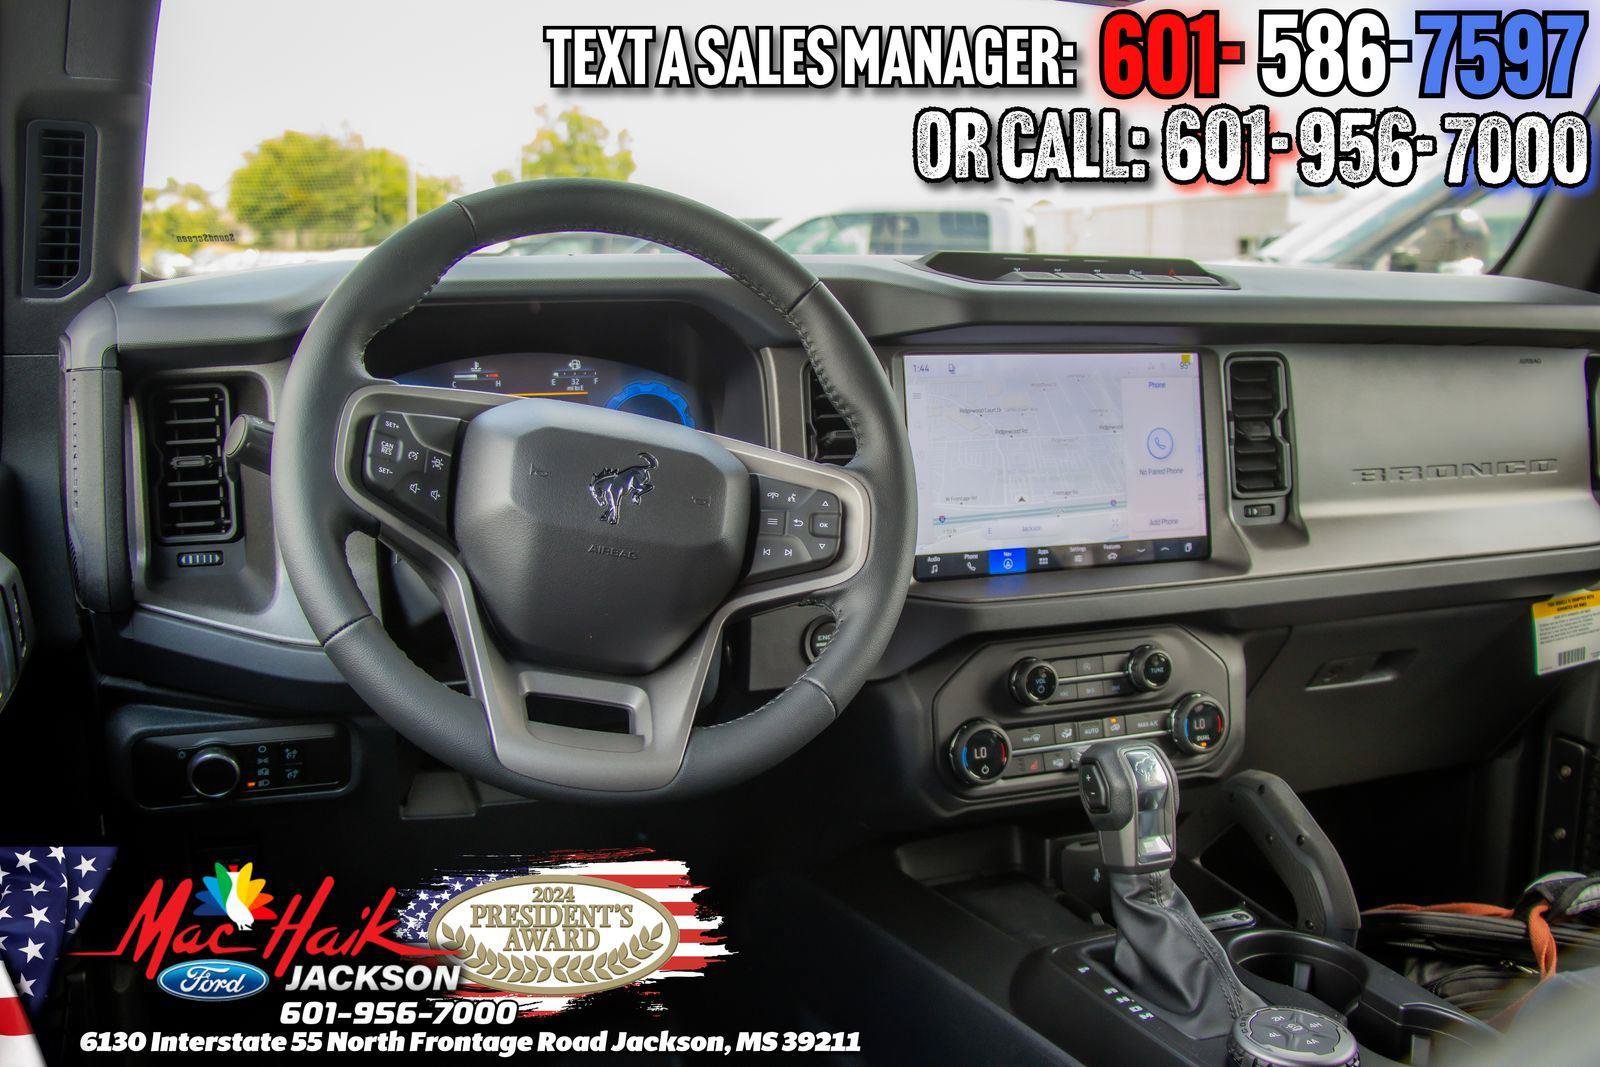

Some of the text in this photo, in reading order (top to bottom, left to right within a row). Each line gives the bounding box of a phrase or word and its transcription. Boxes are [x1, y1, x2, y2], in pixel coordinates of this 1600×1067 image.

[912, 363, 930, 373] 1:44
[1148, 381, 1167, 389] Phone
[381, 441, 394, 450] CAN
[381, 447, 393, 456] RES
[1166, 466, 1184, 475] Phone
[1352, 458, 1558, 485] BRONCO
[1161, 517, 1179, 526] Phone
[927, 555, 941, 563] Audio
[964, 552, 978, 560] Phone
[1084, 726, 1099, 735] AUTO
